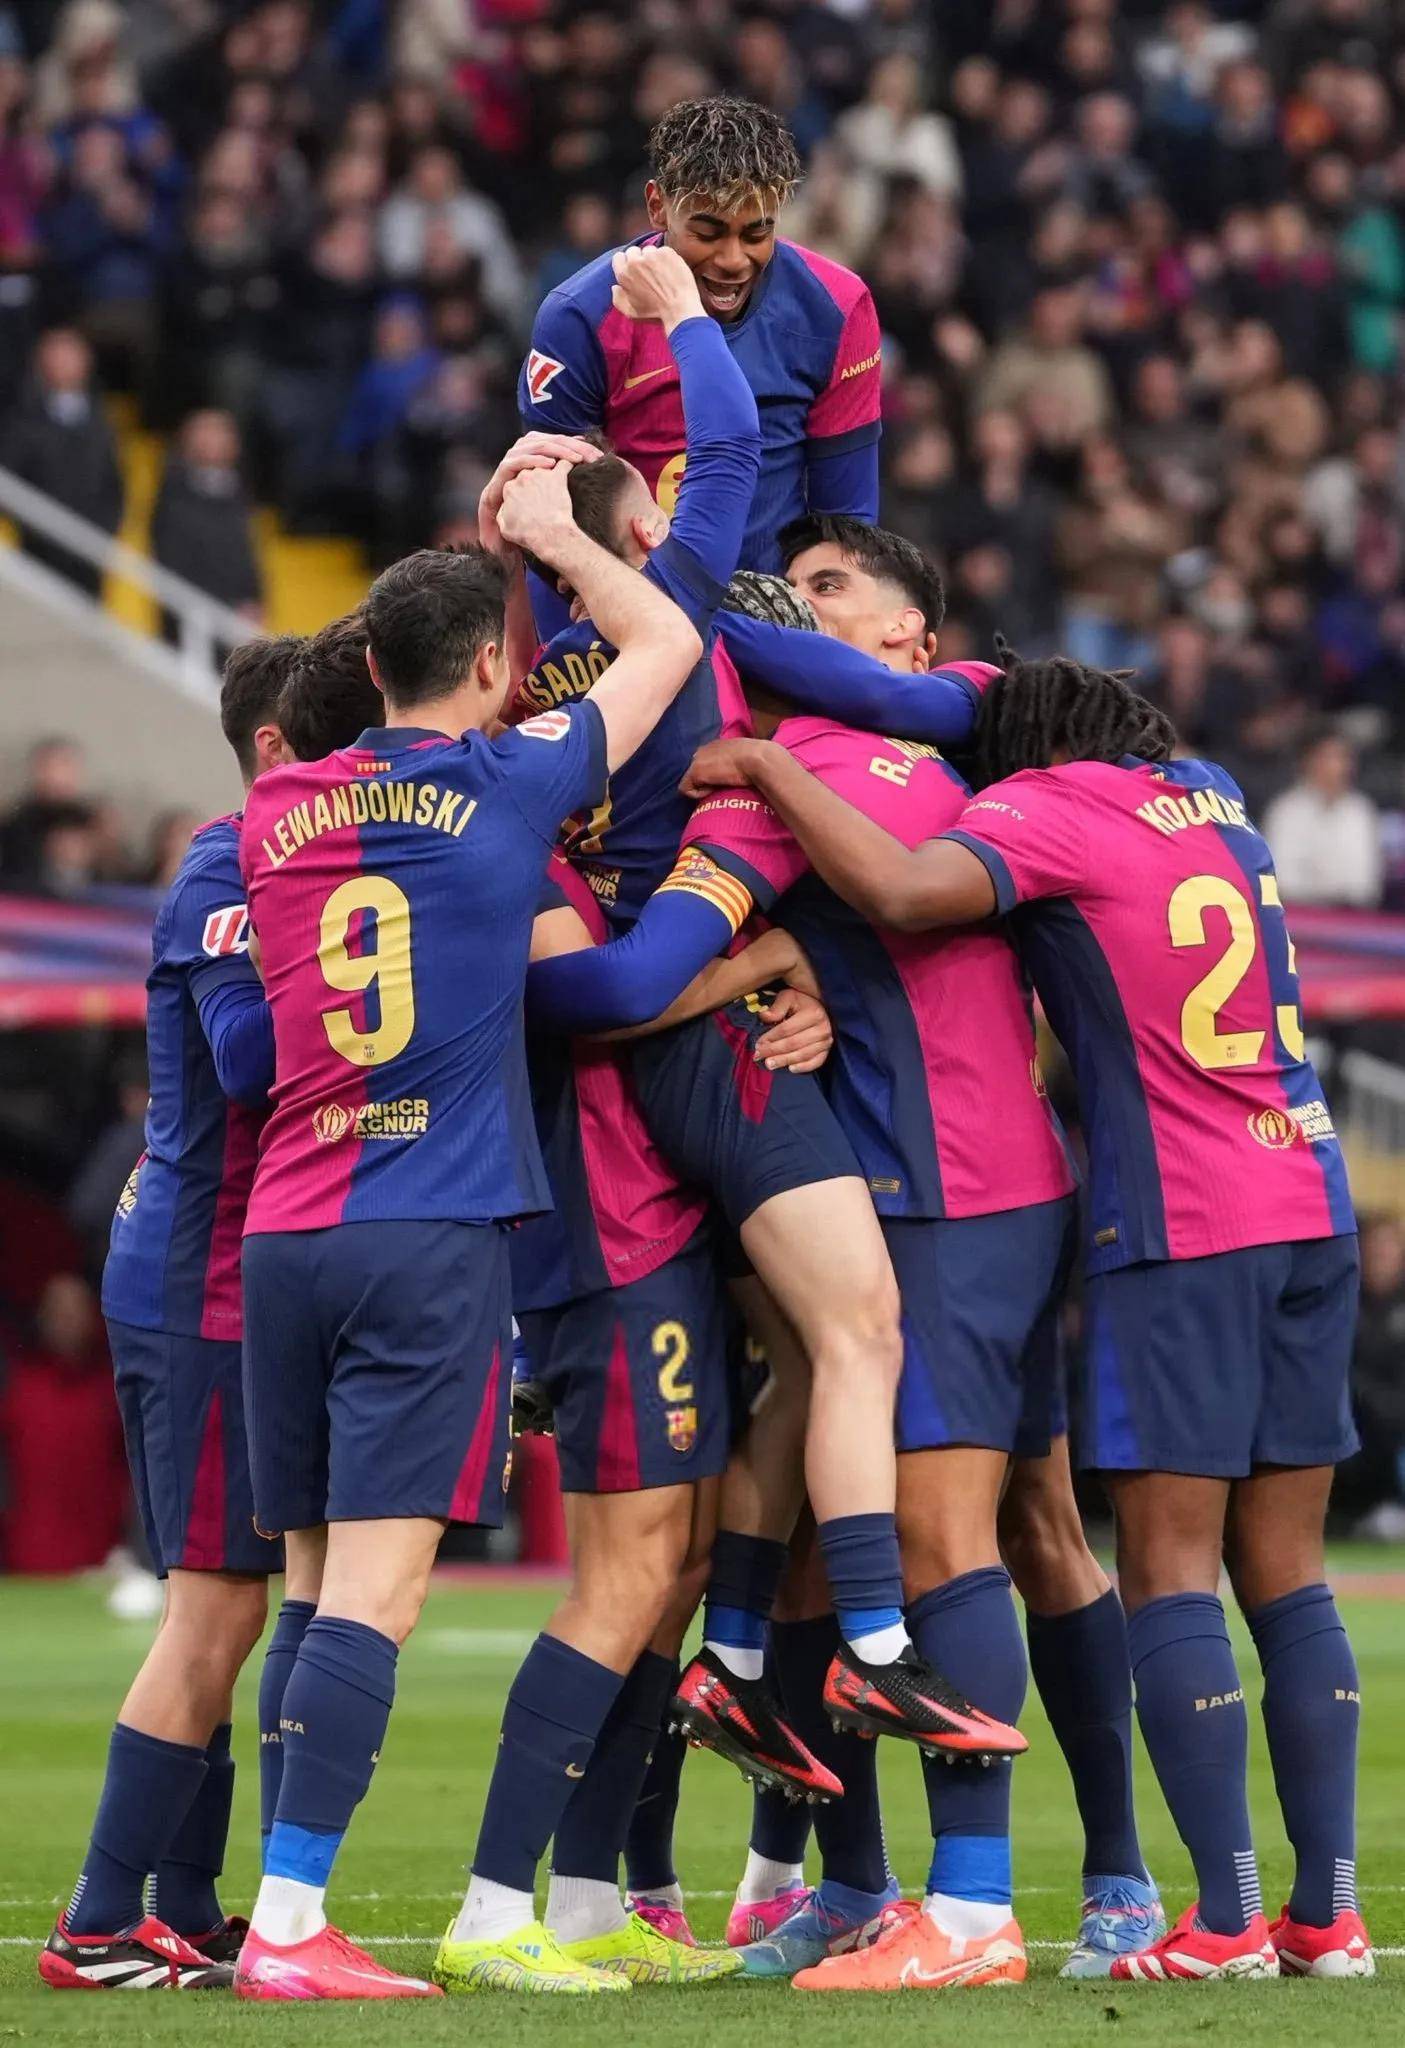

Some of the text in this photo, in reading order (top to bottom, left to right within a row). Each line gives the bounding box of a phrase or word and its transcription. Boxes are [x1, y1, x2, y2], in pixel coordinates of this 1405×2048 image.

[519, 640, 611, 710] SADÓ
[261, 781, 478, 868] LEWANDOWSKI
[316, 875, 415, 1067] 9
[352, 1115, 428, 1135] ACNUR
[356, 1098, 429, 1120] UNHCR
[651, 1320, 694, 1402] 2
